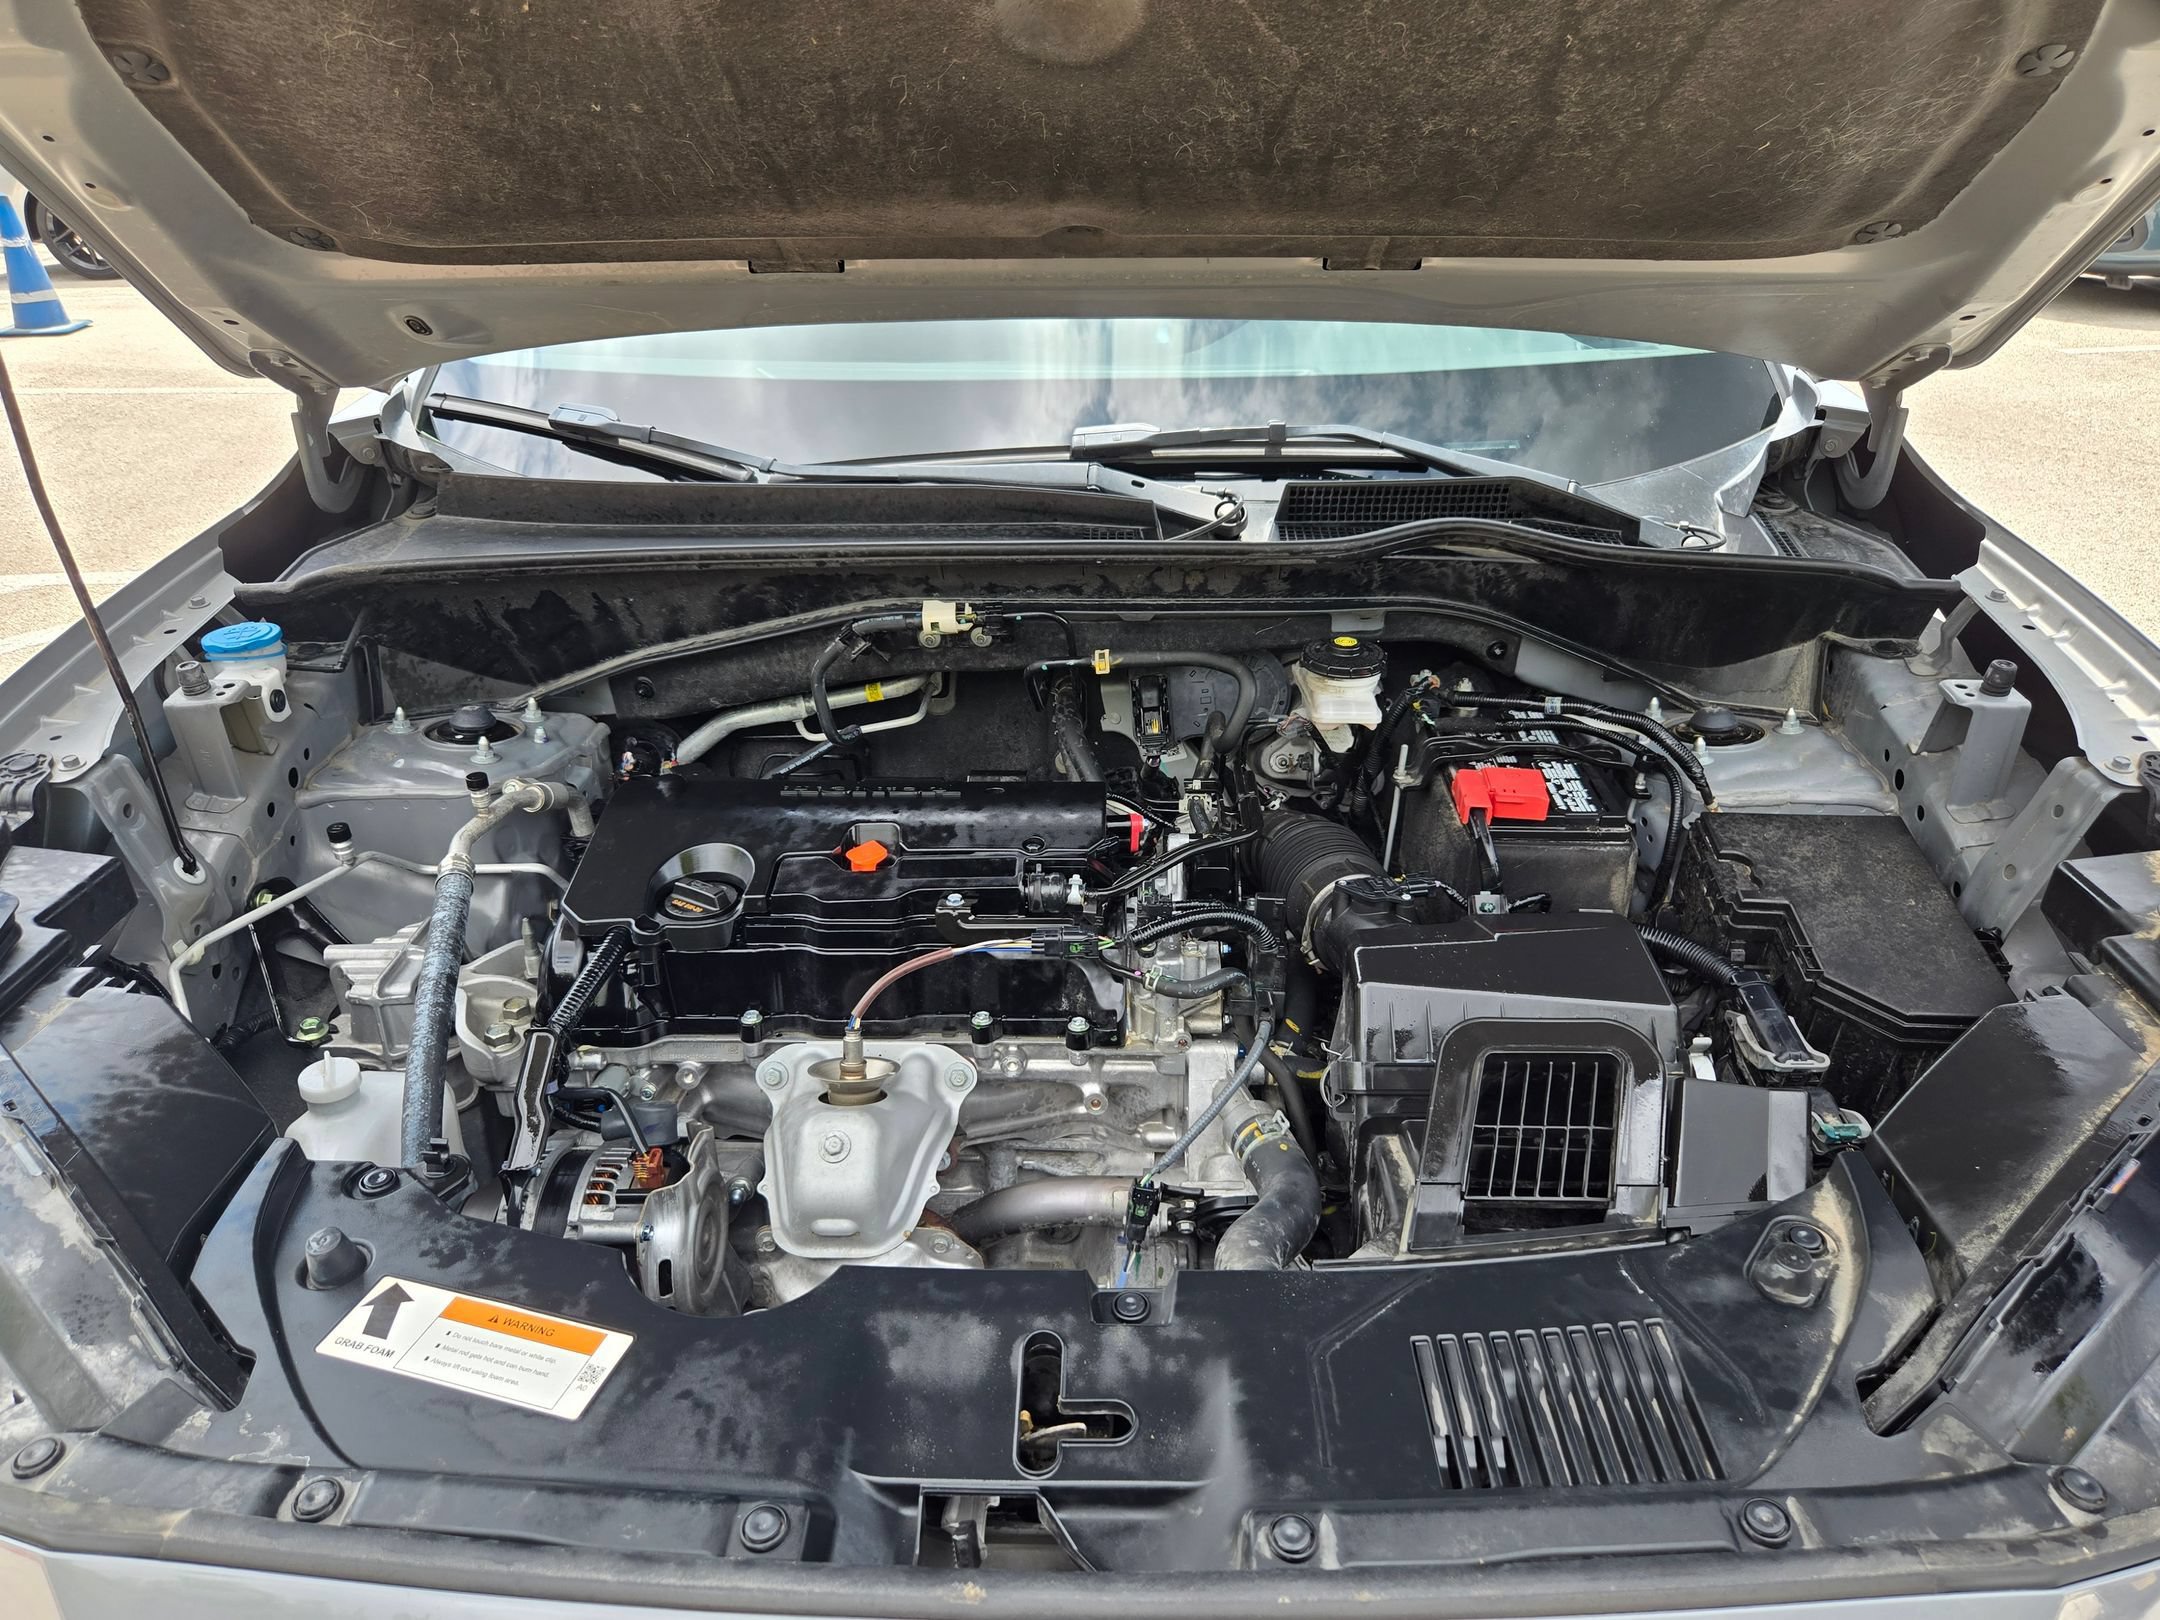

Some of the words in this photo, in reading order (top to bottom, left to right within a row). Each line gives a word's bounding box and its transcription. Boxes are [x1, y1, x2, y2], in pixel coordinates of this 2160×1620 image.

[503, 1317, 555, 1337] WARNING
[334, 1336, 364, 1350] GRAB
[364, 1344, 396, 1358] FOAM
[452, 1331, 462, 1339] Do
[463, 1334, 472, 1342] not
[473, 1336, 489, 1346] touch
[489, 1340, 503, 1350] bare
[504, 1344, 521, 1354] metal
[430, 1356, 452, 1368] Always
[452, 1362, 461, 1370] lift
[460, 1363, 471, 1373] rod
[471, 1368, 488, 1379] using
[489, 1371, 504, 1381] foam
[442, 1344, 459, 1353] Metal
[459, 1348, 469, 1357] rod
[469, 1351, 482, 1361] gets
[483, 1354, 494, 1363] hot
[494, 1357, 506, 1366] and
[506, 1361, 518, 1369] can
[518, 1363, 532, 1372] burn
